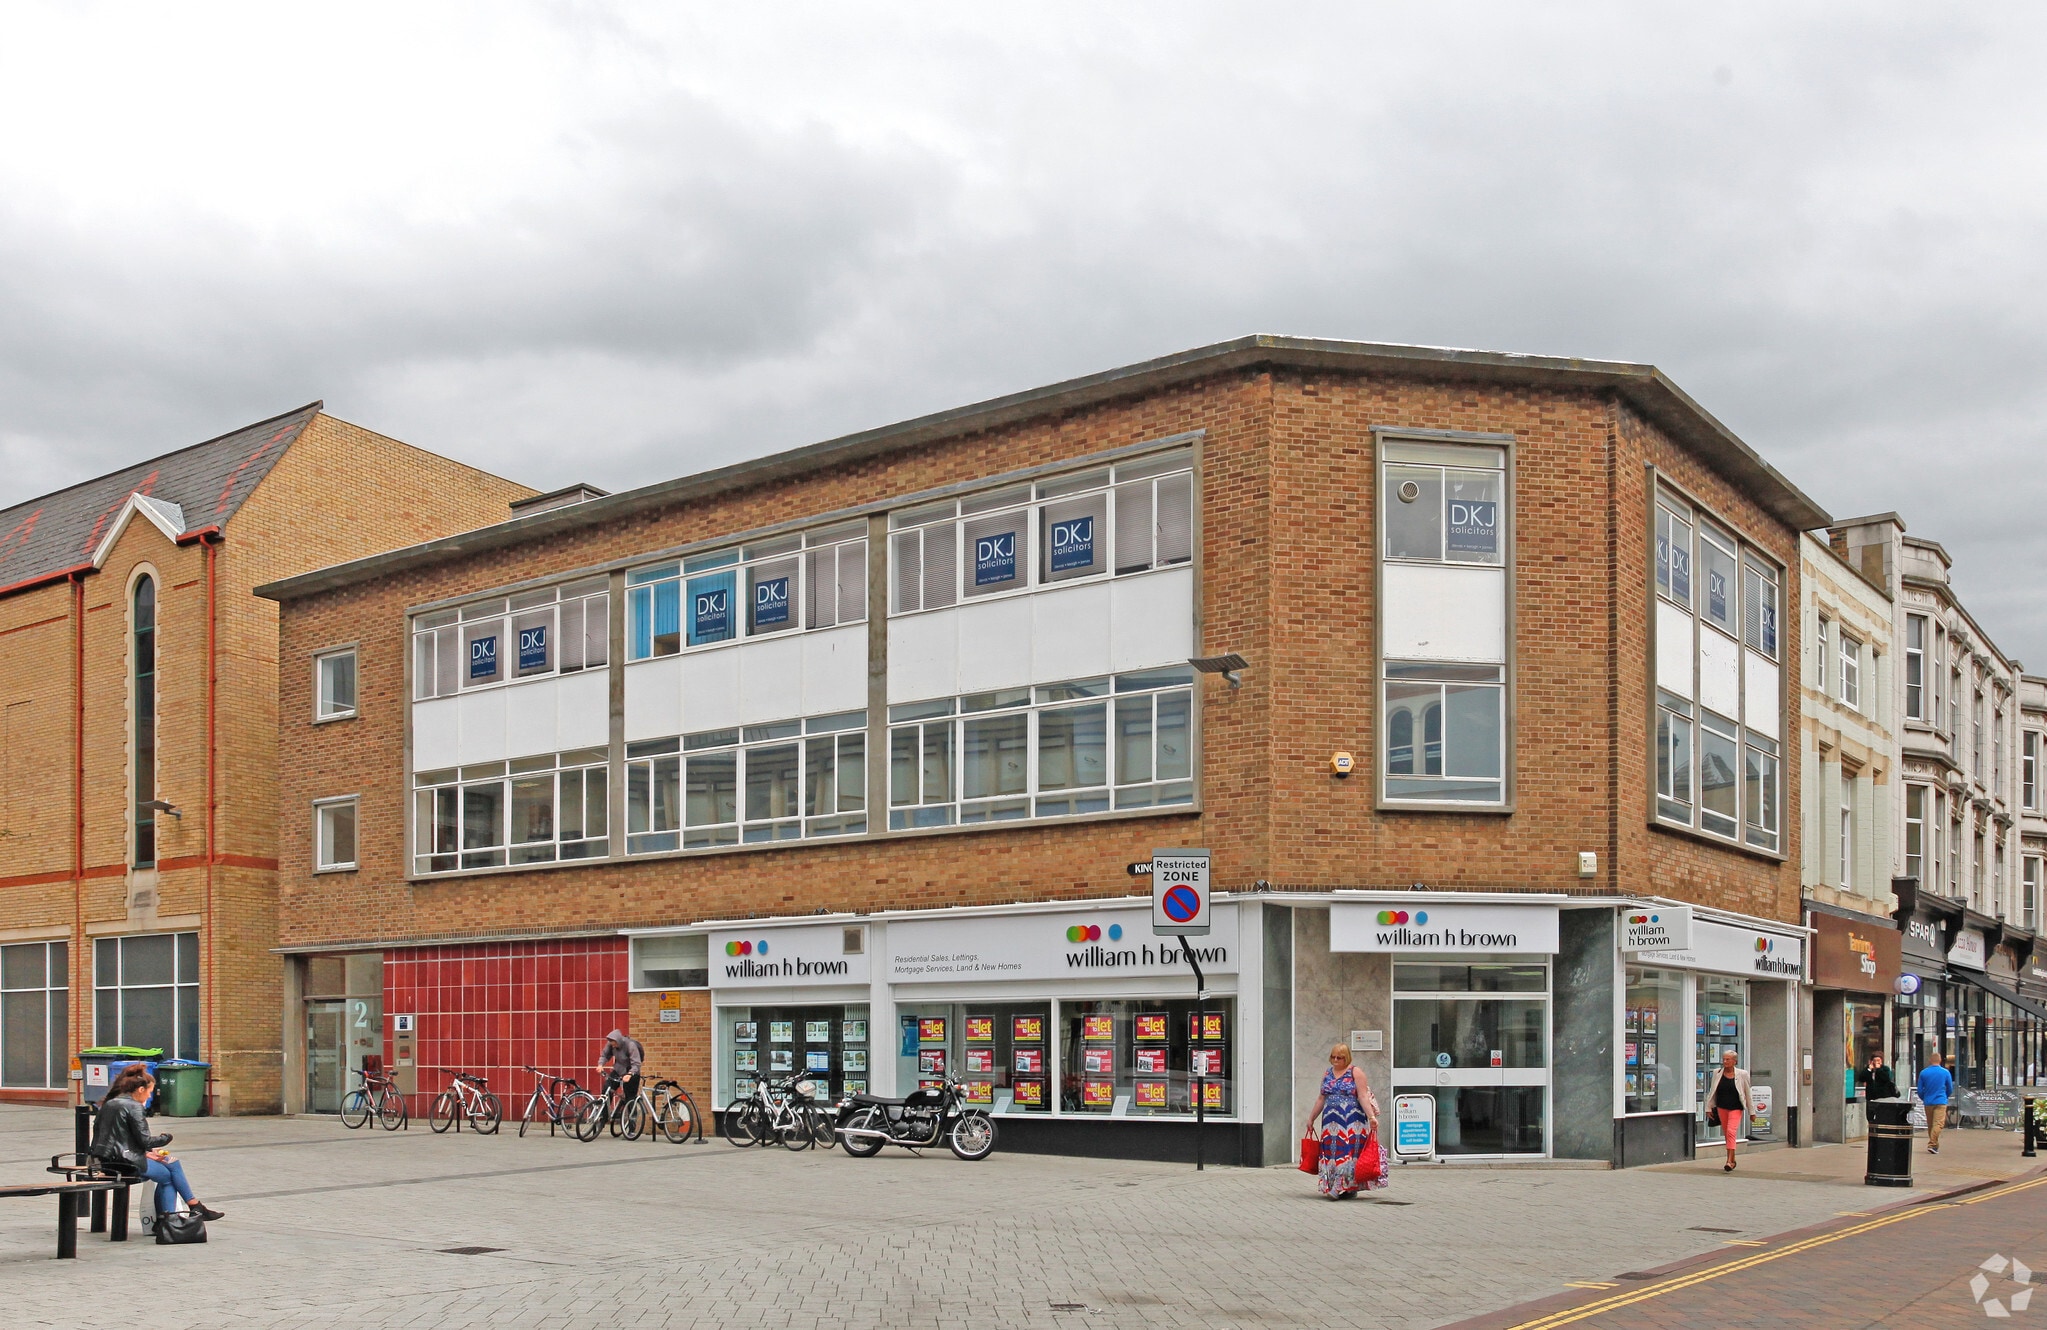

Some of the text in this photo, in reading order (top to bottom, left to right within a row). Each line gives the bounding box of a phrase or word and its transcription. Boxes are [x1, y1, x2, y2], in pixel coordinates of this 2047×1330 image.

[1452, 504, 1494, 527] DKJ
[1054, 521, 1092, 547] DKJ
[1450, 526, 1494, 536] solicitors
[978, 536, 1014, 562] DKJ
[1054, 542, 1091, 556] solicitors
[1656, 539, 1668, 564] KJ
[978, 557, 1013, 570] solicitors
[1672, 549, 1688, 576] DKJ
[758, 581, 788, 604] DKJ
[1710, 574, 1725, 599] DKJ
[698, 593, 726, 615] DKJ
[757, 600, 787, 612] solicitors
[698, 612, 726, 622] solicitors
[520, 630, 546, 650] DKJ
[472, 640, 496, 660] DKJ
[520, 647, 546, 657] solicitors
[472, 657, 496, 666] solicitors
[1156, 860, 1206, 868] Restricted
[1163, 872, 1199, 882] ZONE
[1376, 928, 1516, 946] william h brown
[1628, 925, 1664, 936] william
[1910, 921, 1929, 942] SPAR
[1628, 936, 1670, 946] h brown
[1848, 932, 1871, 959] Tanning
[894, 954, 979, 964] Residential Sales, Lettings,
[1066, 943, 1226, 967] william h brown
[726, 957, 848, 978] william h brown
[894, 966, 924, 974] Mortgage
[926, 964, 954, 973] Services,
[1756, 955, 1777, 972] william
[1782, 958, 1800, 975] brown
[1860, 954, 1876, 980] Shop
[354, 1002, 368, 1028] 2
[932, 1019, 944, 1034] let
[979, 1019, 992, 1033] let
[1028, 1019, 1041, 1033] let
[1098, 1017, 1112, 1032] let
[1150, 1017, 1165, 1032] let
[1205, 1016, 1221, 1032] let
[979, 1081, 992, 1096] let
[1028, 1082, 1041, 1096] let
[1098, 1083, 1112, 1097] let
[1150, 1083, 1165, 1098] let
[1205, 1084, 1221, 1099] let
